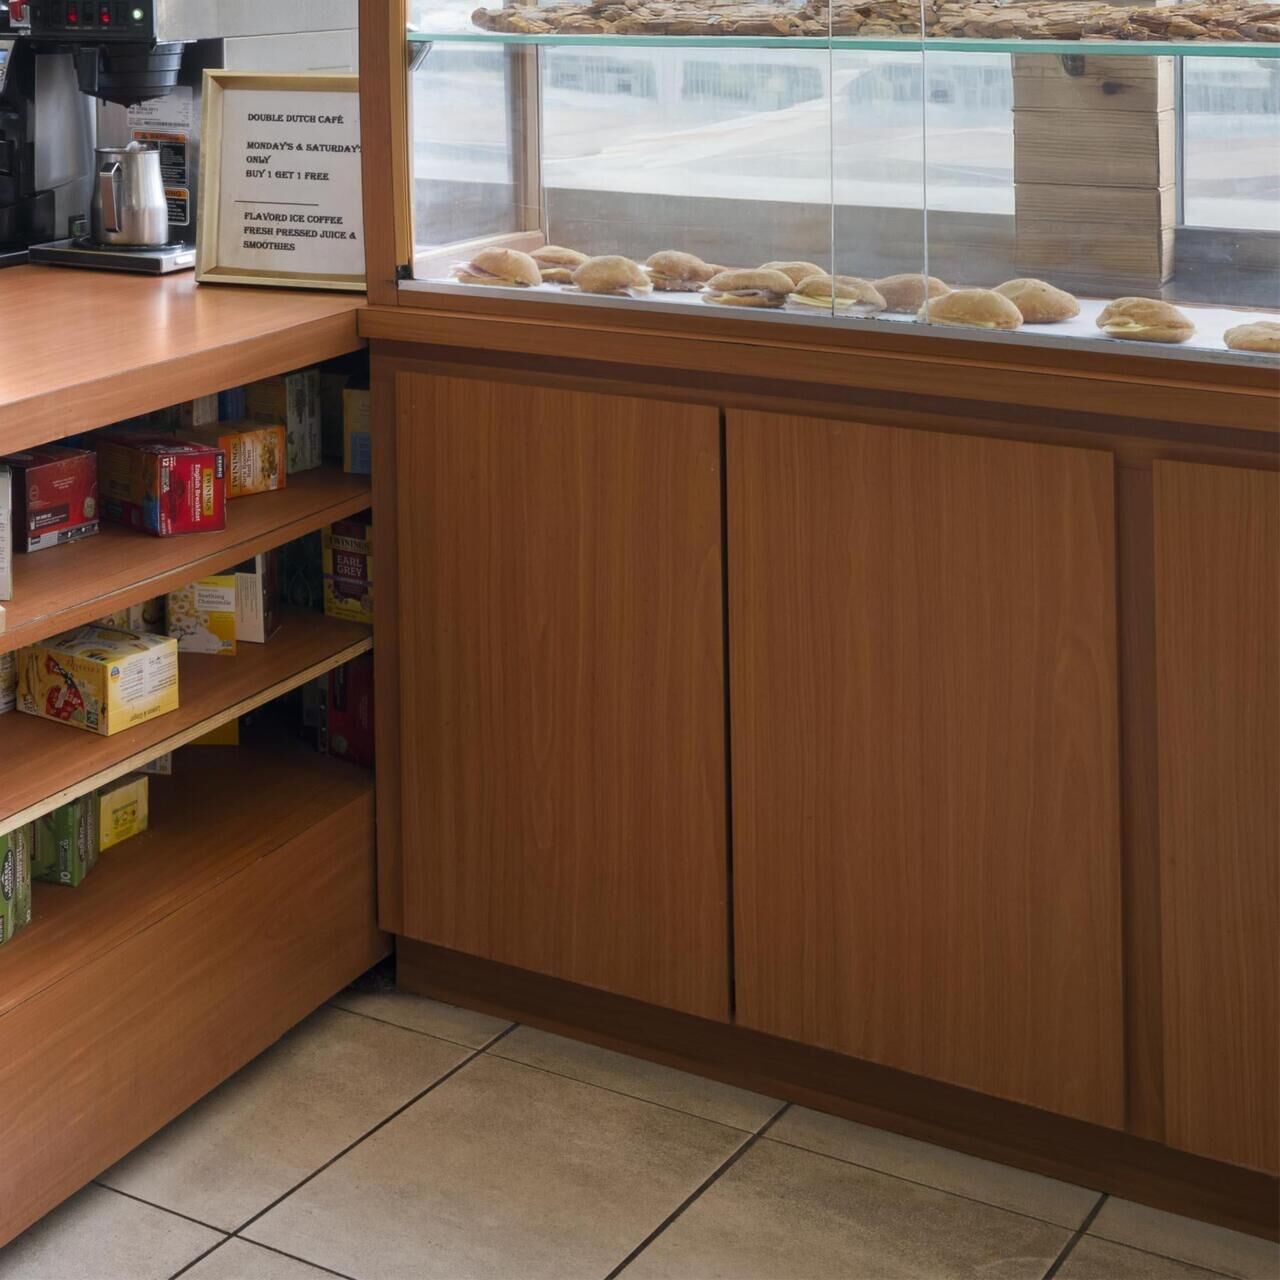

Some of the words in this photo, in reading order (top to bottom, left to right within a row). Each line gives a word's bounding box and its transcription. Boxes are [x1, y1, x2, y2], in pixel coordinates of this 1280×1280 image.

[248, 113, 284, 122] DOUBLE
[286, 114, 316, 124] DUTCH
[318, 114, 344, 124] CAFÉ
[247, 141, 294, 151] MONDAY'S
[246, 155, 271, 164] ONLY
[246, 169, 266, 178] BUY
[275, 170, 294, 179] GET
[304, 172, 329, 181] FREE
[244, 212, 287, 222] FLAVORD
[289, 214, 305, 223] ICE
[307, 215, 343, 224] COFFEE
[244, 226, 273, 235] FRESH
[276, 228, 317, 238] PRESSED
[320, 230, 346, 239] JUICE
[349, 231, 357, 240] &
[243, 241, 295, 251] SMOOTHIES
[337, 554, 362, 567] EARL
[337, 565, 362, 577] GREY
